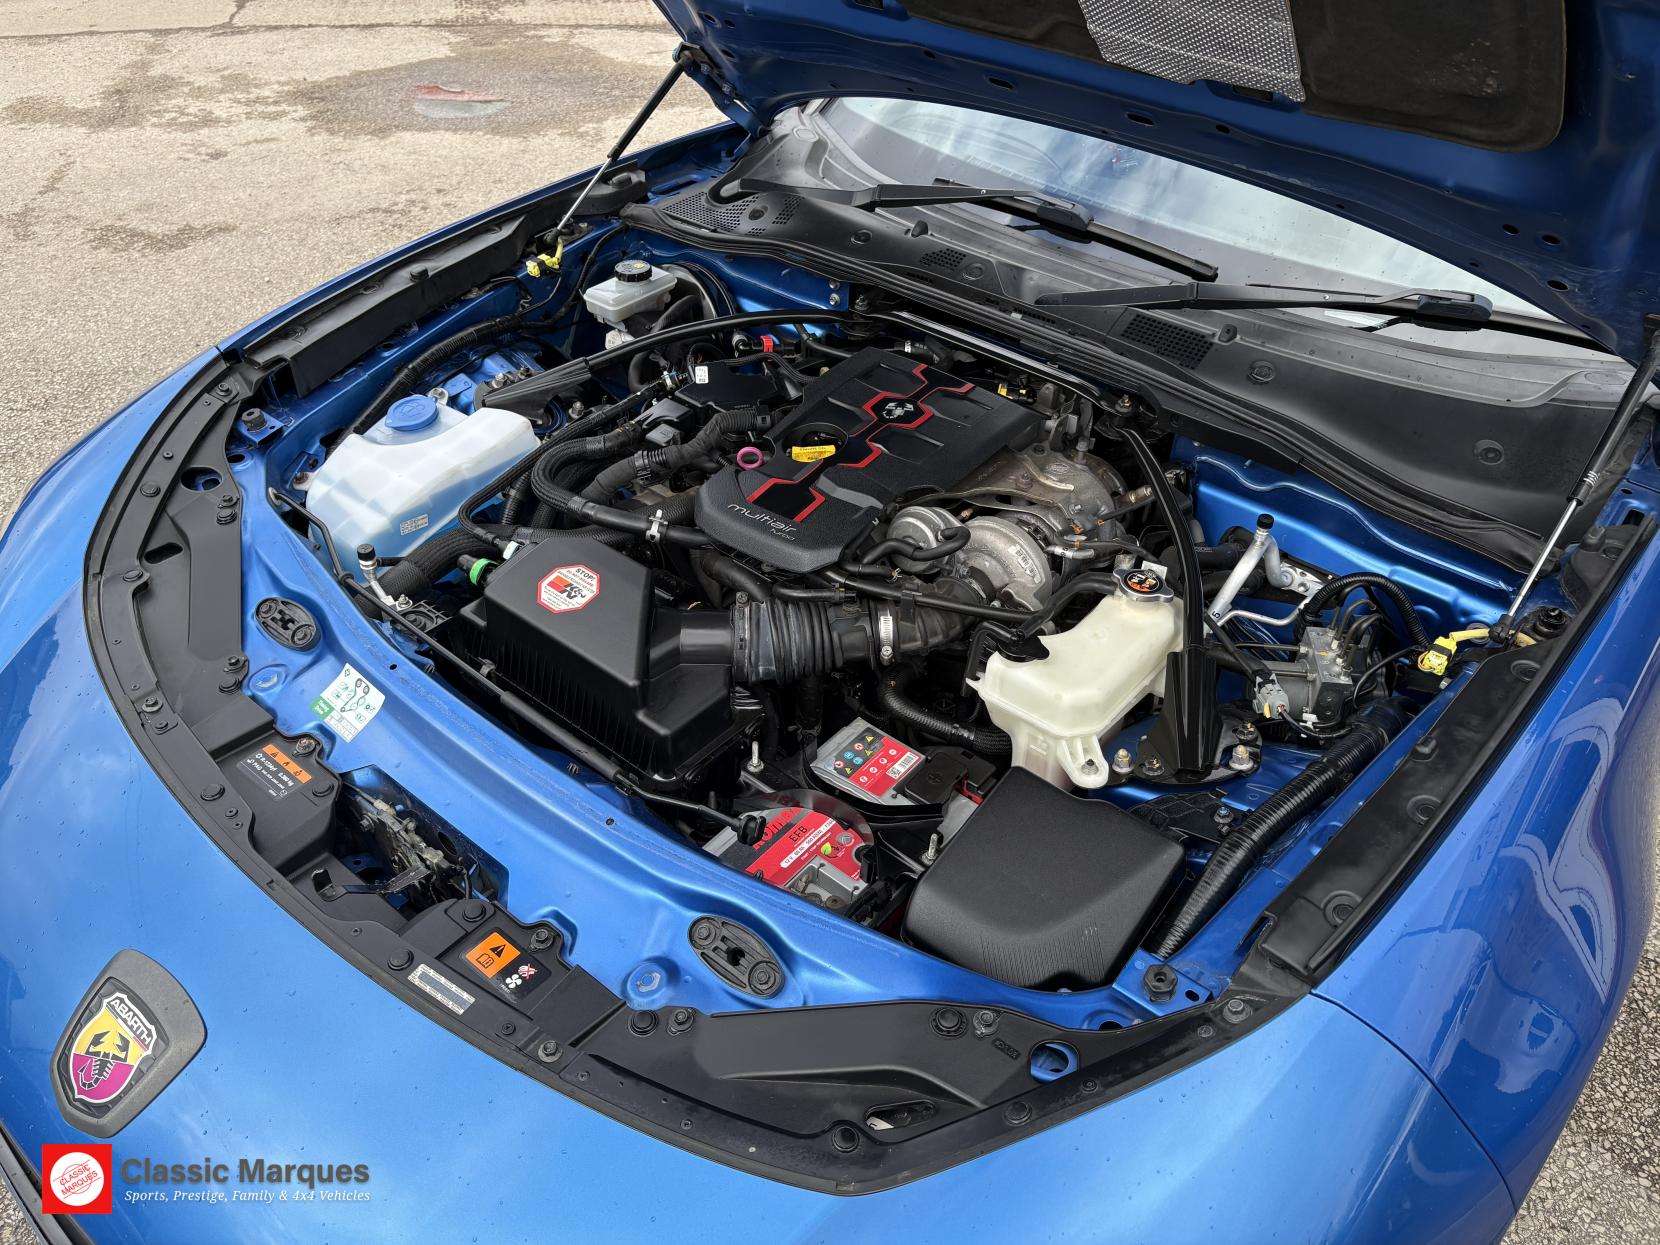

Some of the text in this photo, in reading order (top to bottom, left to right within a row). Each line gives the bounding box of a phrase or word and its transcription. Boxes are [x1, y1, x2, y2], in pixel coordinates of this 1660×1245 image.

[727, 504, 797, 532] multiair
[789, 826, 808, 842] EFB
[110, 999, 152, 1045] ABARTH
